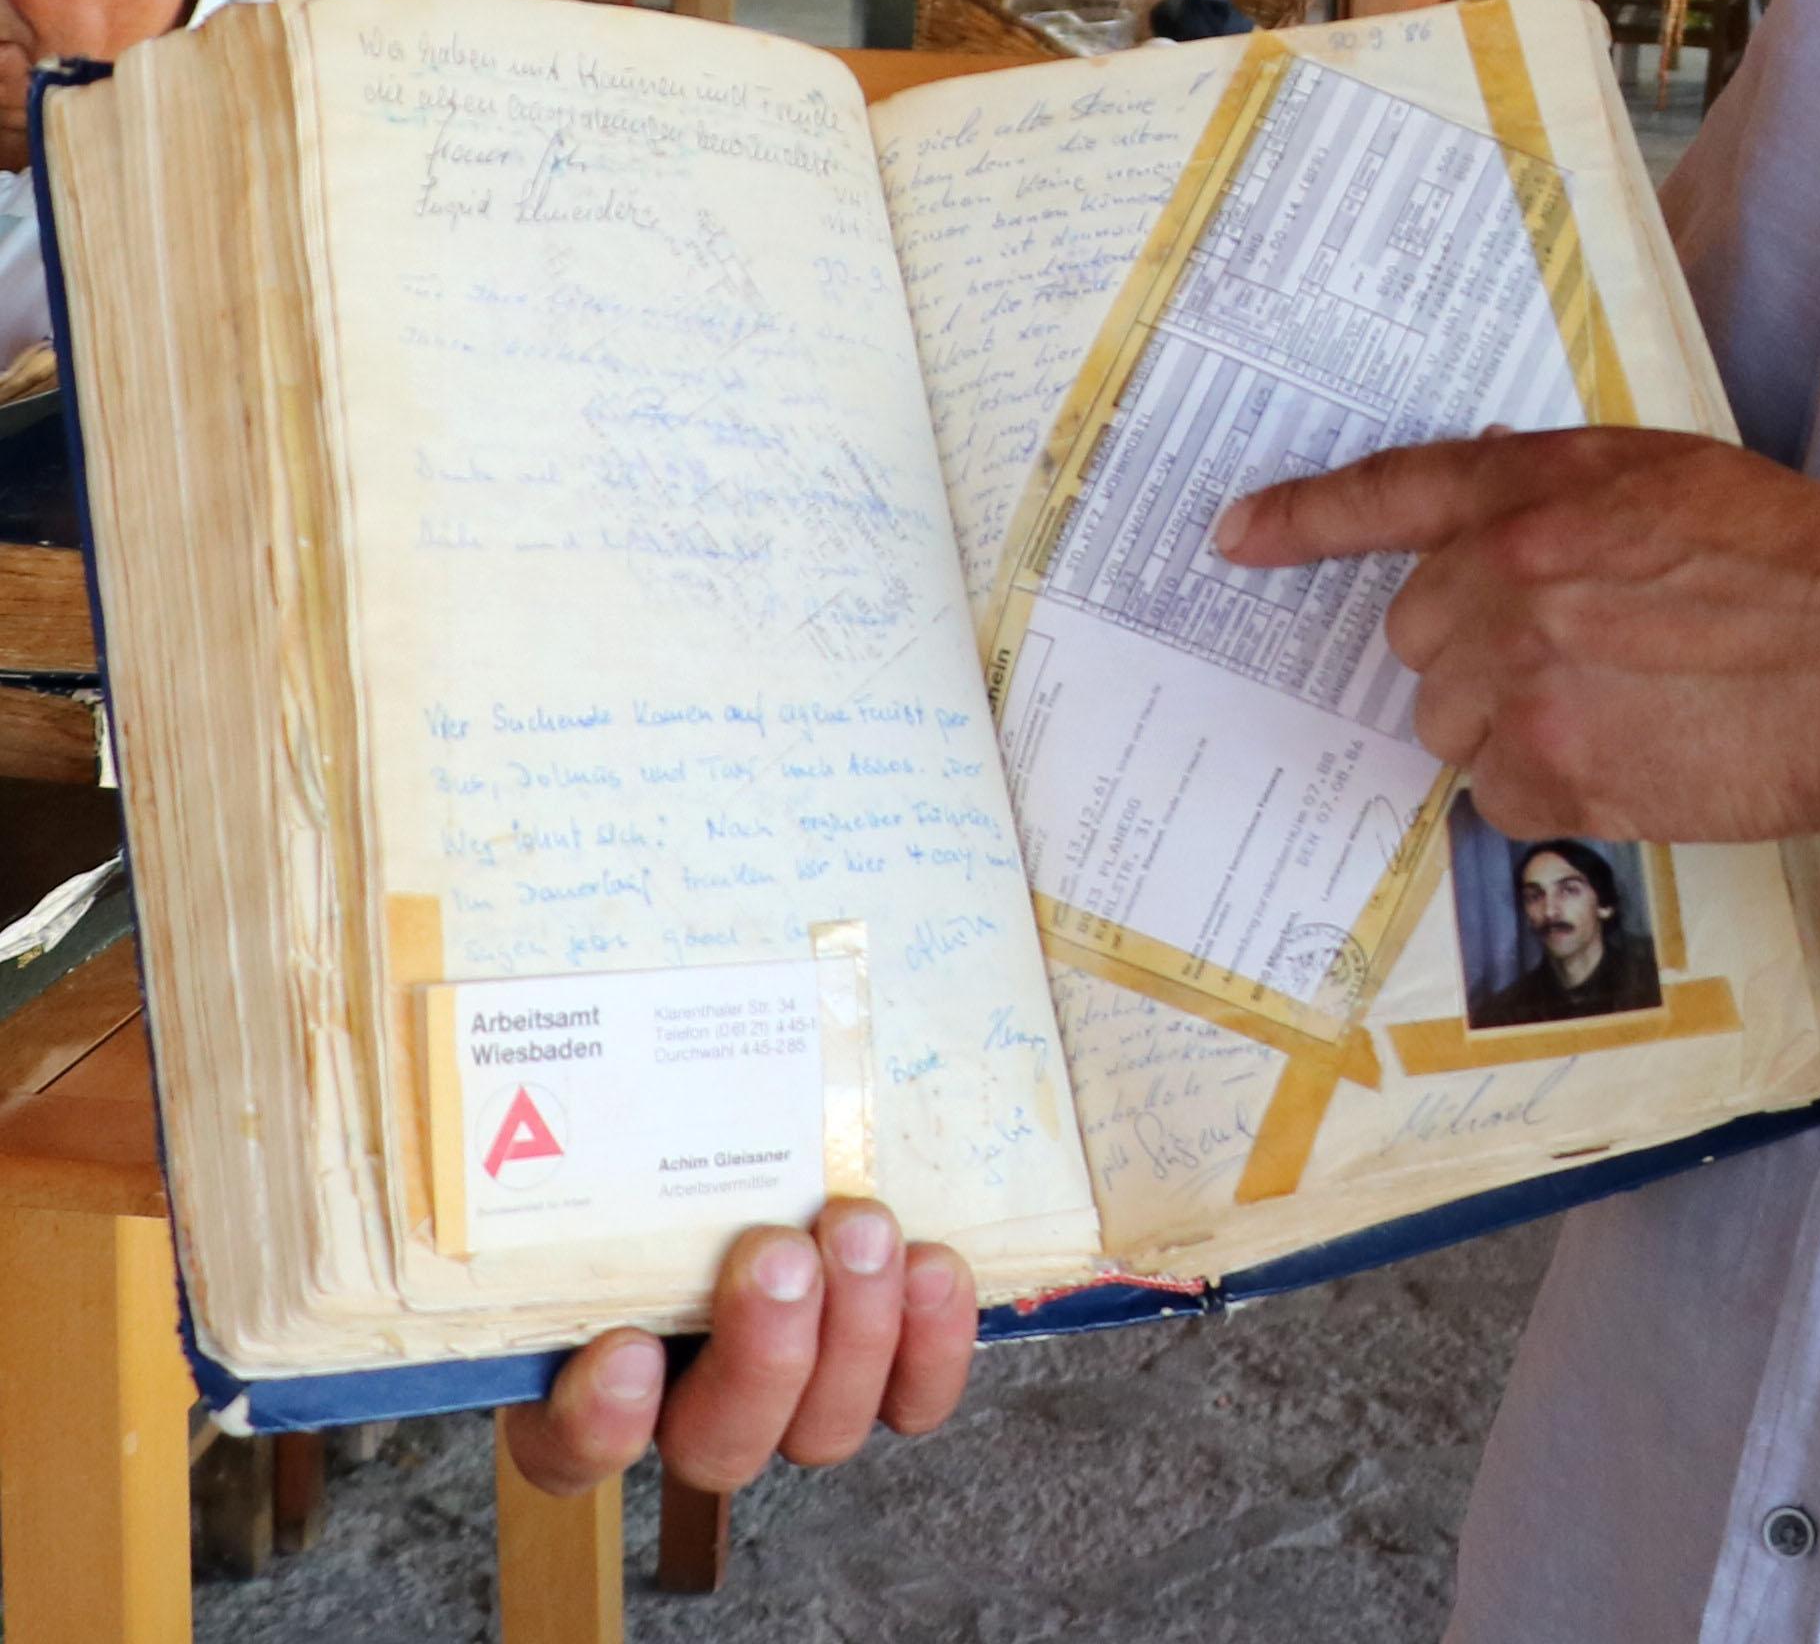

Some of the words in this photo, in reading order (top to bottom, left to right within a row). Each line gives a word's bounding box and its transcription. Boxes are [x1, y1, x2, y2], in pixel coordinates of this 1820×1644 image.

[471, 1005, 601, 1035] Arbeitsamt
[471, 1038, 603, 1068] Wiesbaden
[658, 1155, 710, 1173] Achim
